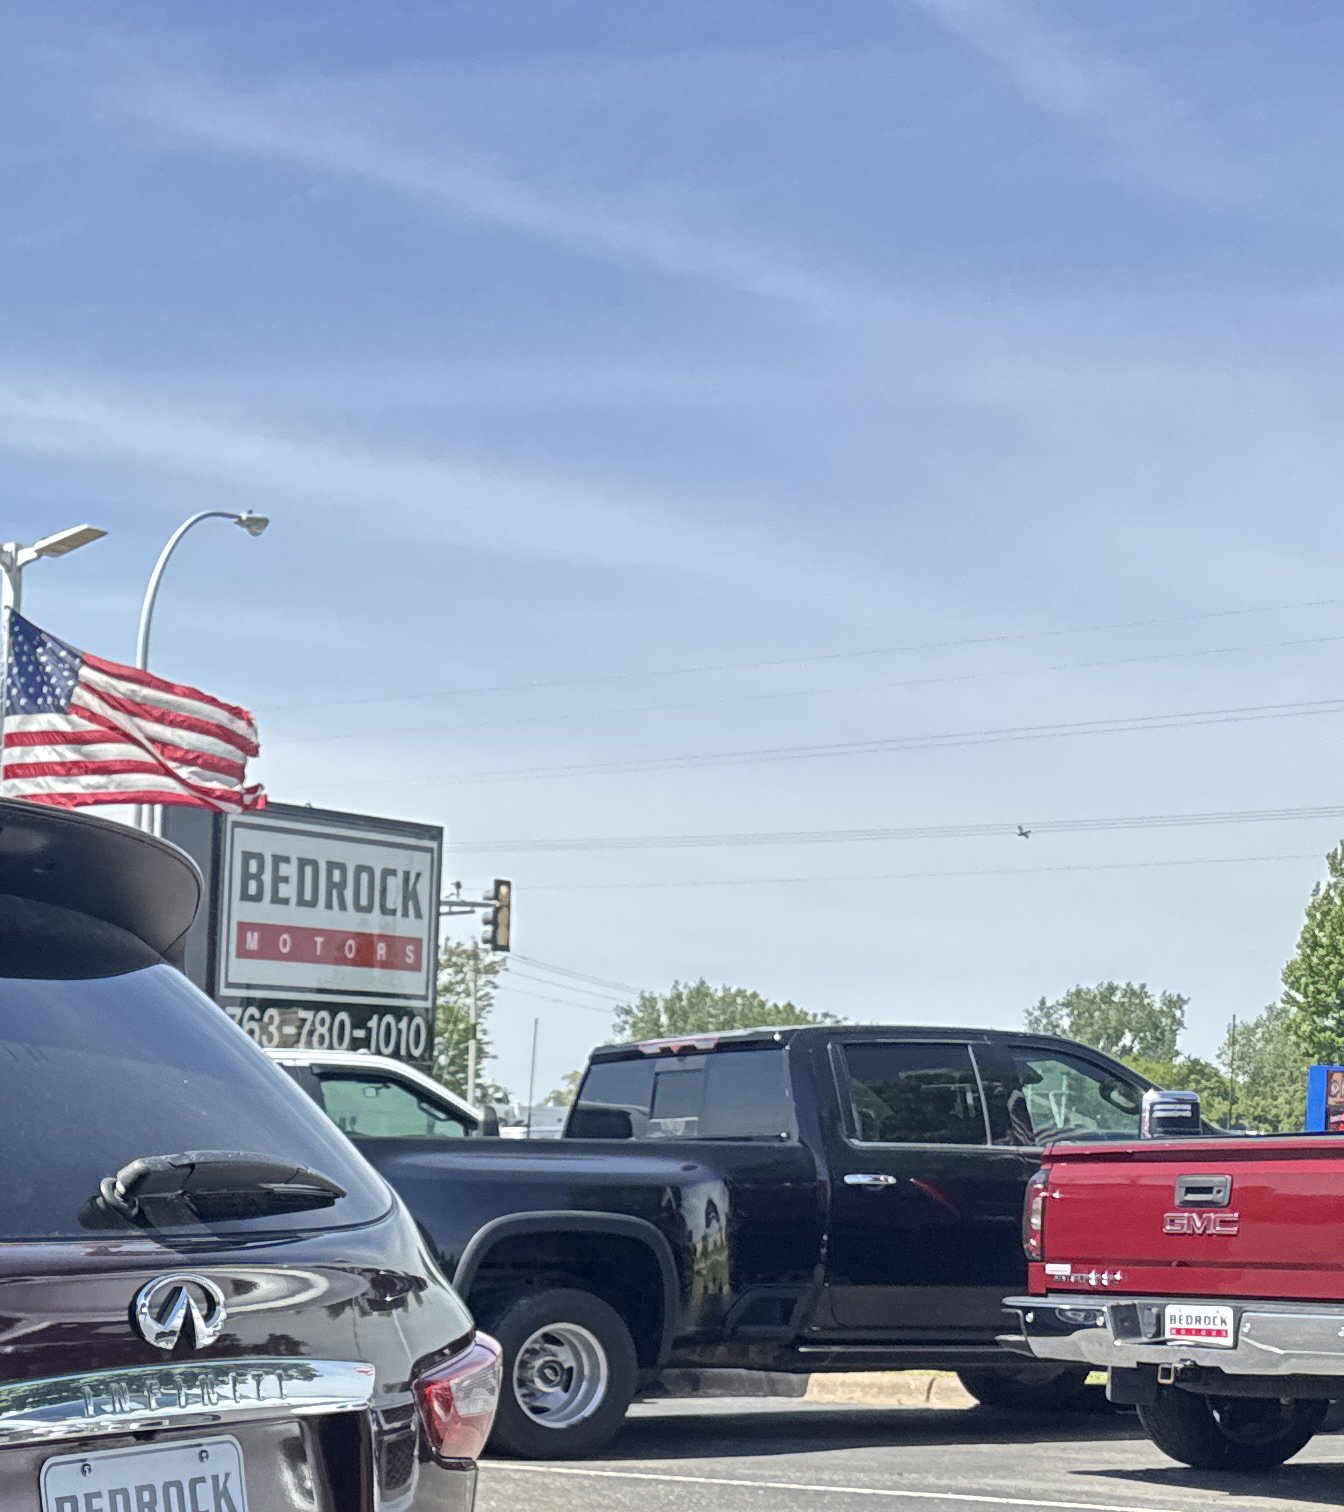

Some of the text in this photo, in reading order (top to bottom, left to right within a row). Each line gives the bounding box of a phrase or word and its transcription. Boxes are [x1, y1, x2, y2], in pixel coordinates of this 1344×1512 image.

[239, 850, 423, 919] BEDROCK
[245, 931, 416, 964] MOTORS
[1162, 1212, 1239, 1235] GMC
[1169, 1314, 1228, 1327] BEDROCK
